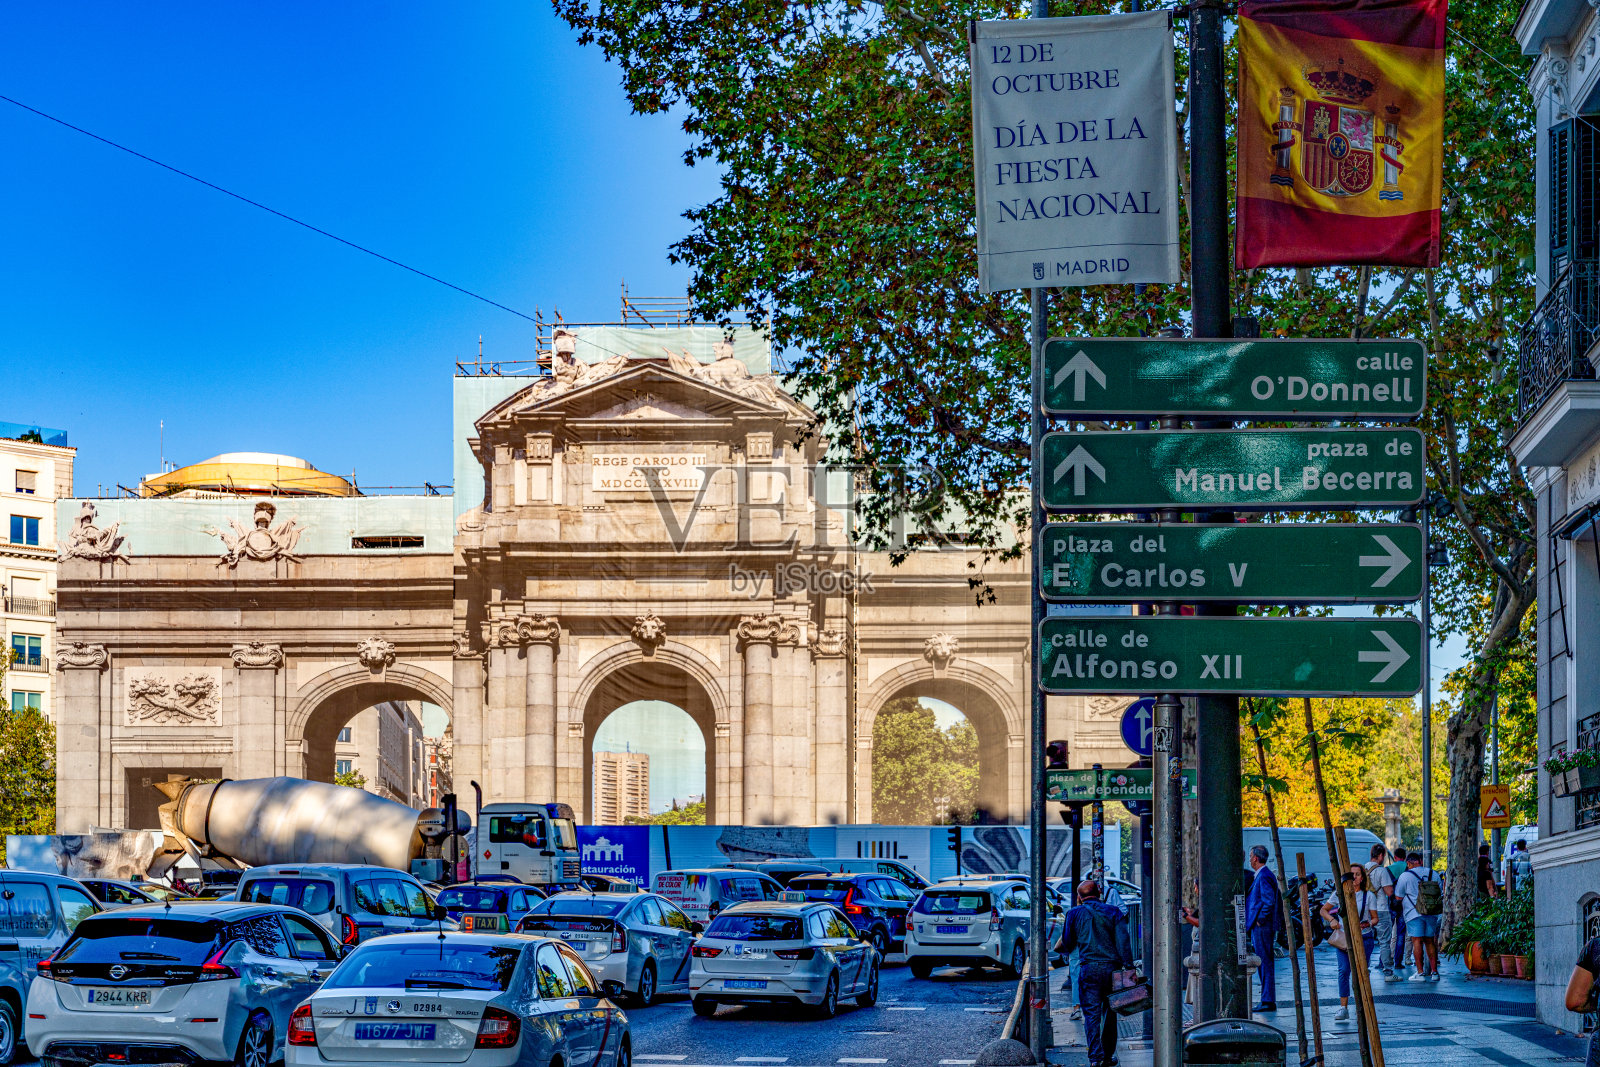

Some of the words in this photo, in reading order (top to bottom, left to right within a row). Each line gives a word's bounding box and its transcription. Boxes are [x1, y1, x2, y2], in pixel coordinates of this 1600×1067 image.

[990, 44, 1011, 65] 12
[1017, 43, 1055, 63] DE
[991, 68, 1120, 96] OCTUBRE
[993, 118, 1051, 149] DÍA
[1056, 119, 1100, 144] DE
[1105, 116, 1148, 141] LA
[995, 156, 1100, 186] FIESTA
[997, 190, 1161, 223] NACIONAL
[1056, 257, 1131, 278] MADRID
[1356, 352, 1413, 371] calle
[1251, 375, 1413, 403] O'Donnell
[1307, 440, 1368, 460] plaza
[1385, 438, 1413, 456] de
[592, 457, 628, 466] REGE
[633, 457, 688, 466] CAROLO
[692, 456, 706, 466] III
[629, 468, 671, 477] ANNO
[1174, 466, 1283, 493] Manuel
[1303, 465, 1413, 491] Becerra
[1053, 534, 1114, 556] plaza
[1129, 534, 1167, 553] del
[1100, 562, 1206, 588] Carlos
[1228, 562, 1248, 588] V
[1051, 629, 1108, 648] calle
[1121, 629, 1149, 648] de
[1051, 653, 1178, 680] Alfonso
[1200, 655, 1243, 680] XII
[1049, 774, 1075, 783] plaza
[1080, 774, 1093, 782] de
[1098, 773, 1108, 782] la
[464, 916, 473, 930] 9
[477, 918, 497, 929] TAXI
[96, 991, 123, 1002] 2944
[126, 992, 148, 1002] KRR
[413, 1003, 442, 1013] 02984
[365, 1024, 399, 1038] 1677
[404, 1025, 432, 1038] JWF
